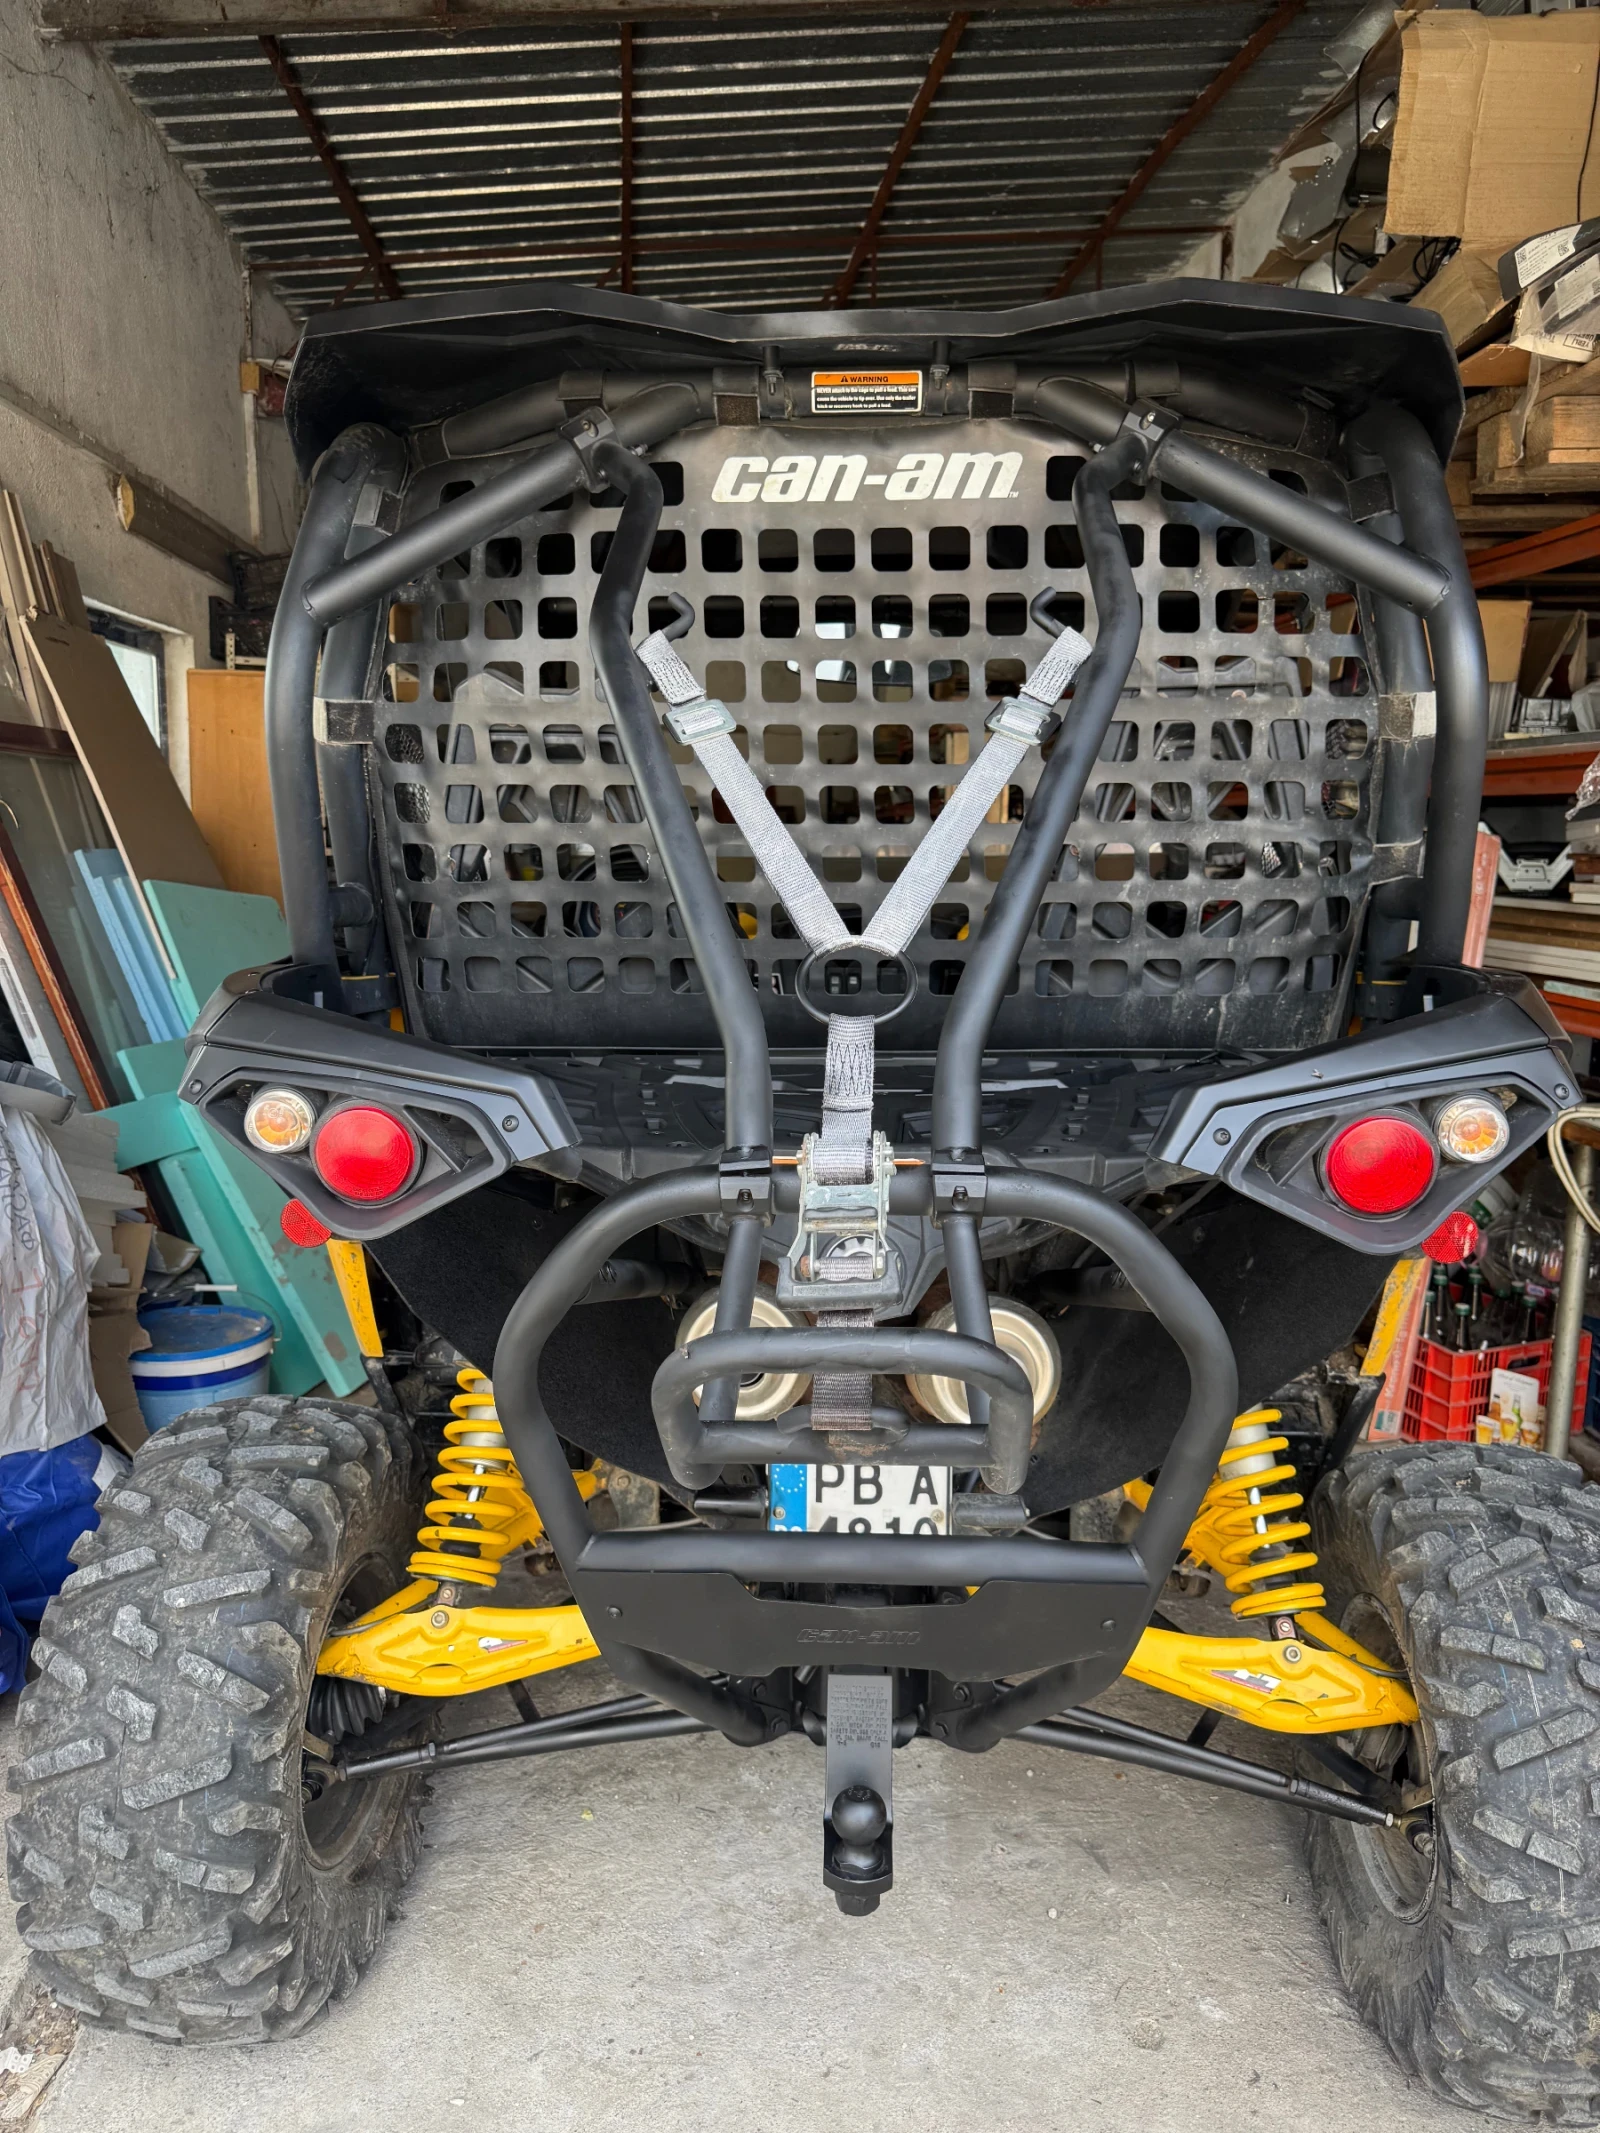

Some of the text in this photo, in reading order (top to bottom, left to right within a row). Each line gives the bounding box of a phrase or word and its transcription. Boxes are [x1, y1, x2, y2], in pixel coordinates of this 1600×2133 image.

[711, 451, 1023, 502] can-am
[815, 1464, 938, 1505] PB A
